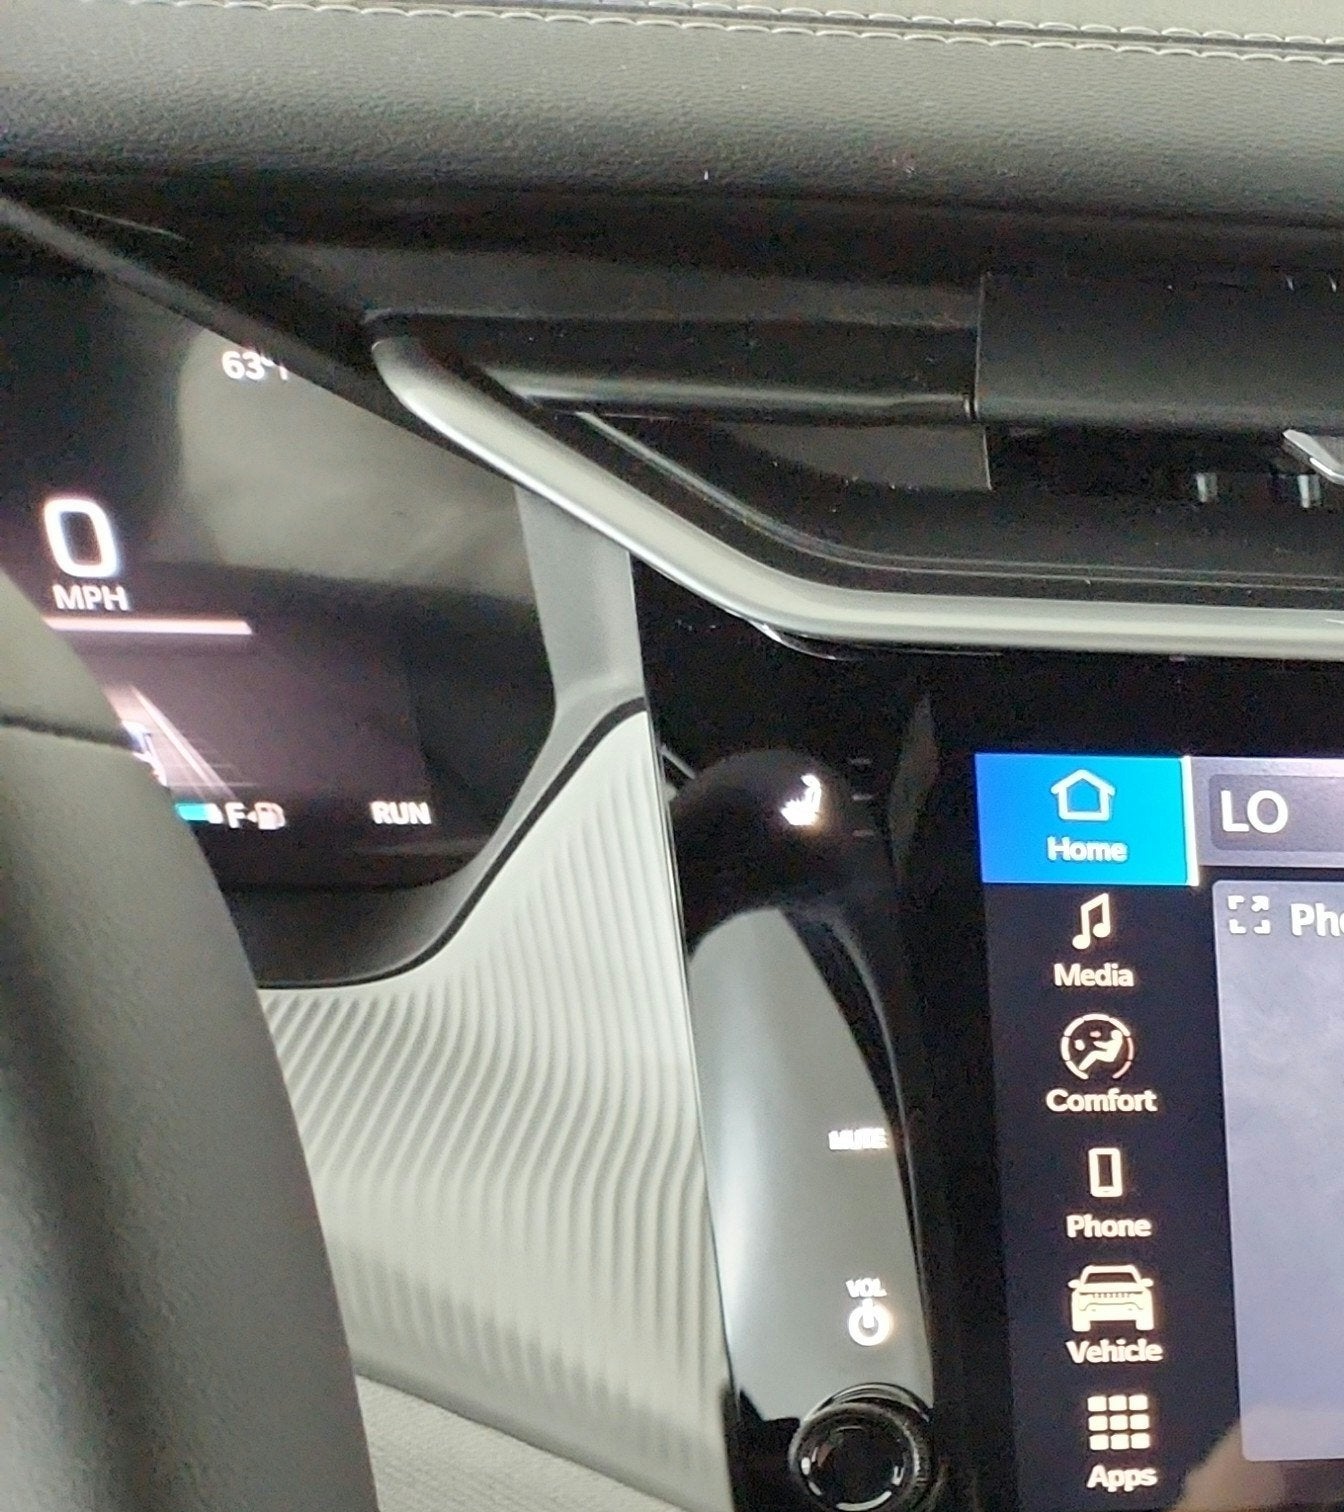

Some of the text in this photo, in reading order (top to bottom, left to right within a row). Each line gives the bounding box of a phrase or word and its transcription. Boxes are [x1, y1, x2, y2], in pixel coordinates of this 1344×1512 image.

[43, 494, 119, 579] 0
[52, 583, 130, 612] MPH
[370, 800, 432, 825] RUN
[1219, 789, 1290, 834] LO
[1046, 836, 1129, 864] Home
[1053, 962, 1135, 988] Media
[1045, 1087, 1159, 1113] Comfort
[1066, 1214, 1153, 1239] Phone
[844, 1276, 888, 1299] VOL
[1066, 1338, 1164, 1364] Vehicle
[1086, 1465, 1159, 1493] Apps
